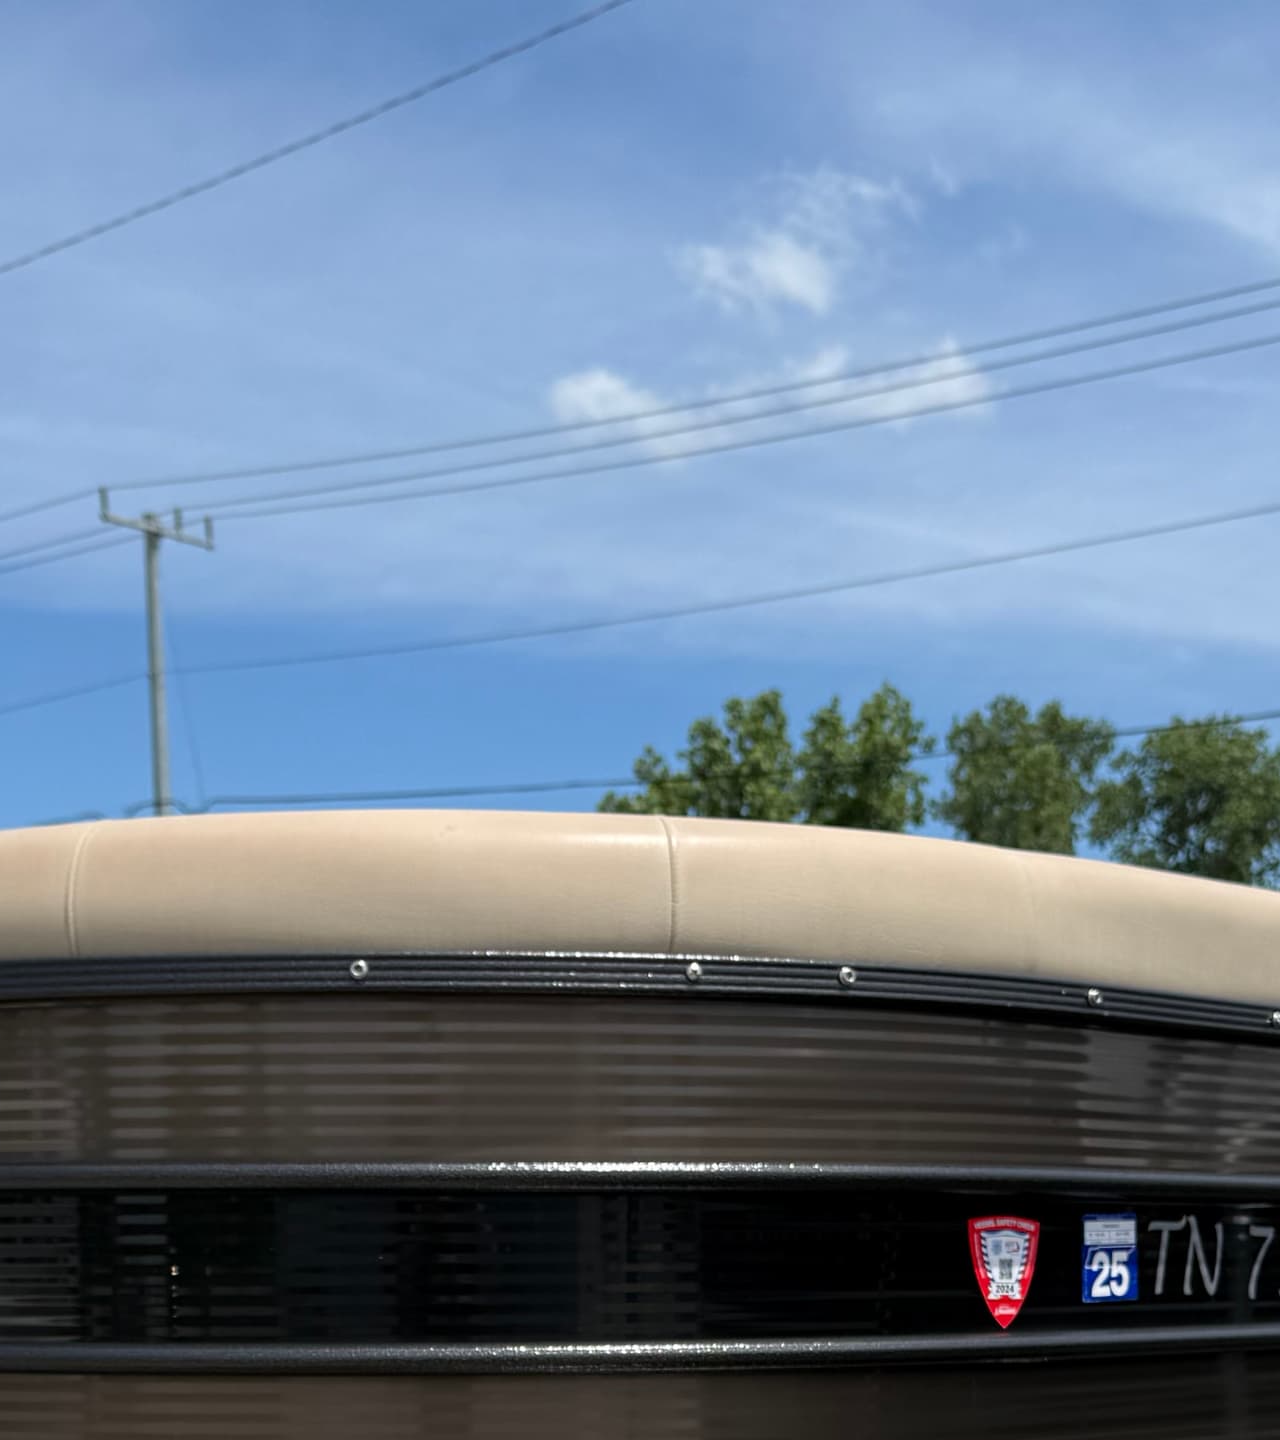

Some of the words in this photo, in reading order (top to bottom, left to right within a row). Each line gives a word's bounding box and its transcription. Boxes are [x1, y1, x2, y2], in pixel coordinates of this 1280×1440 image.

[1091, 1250, 1130, 1297] 25
[1148, 1214, 1224, 1296] TN
[995, 1284, 1015, 1294] 2024
